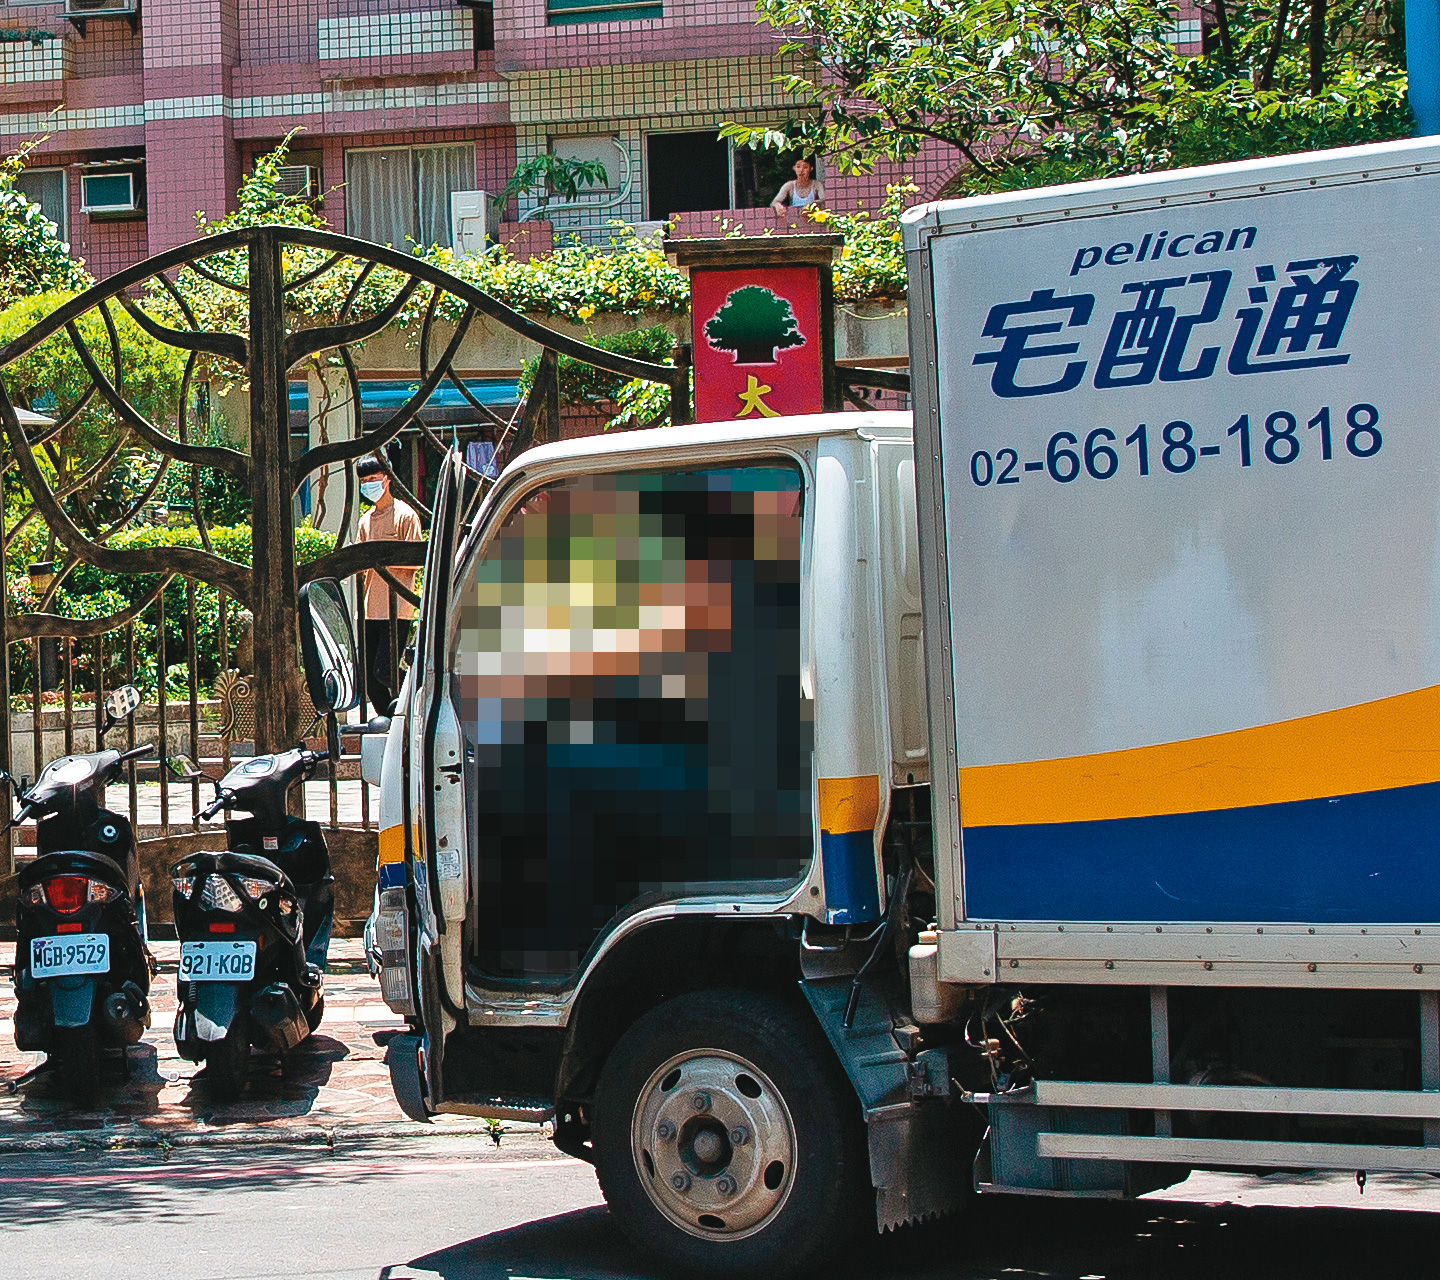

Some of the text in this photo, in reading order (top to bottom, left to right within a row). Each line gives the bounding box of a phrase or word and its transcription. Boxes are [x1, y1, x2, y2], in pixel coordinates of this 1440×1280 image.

[1069, 225, 1258, 276] pelican
[971, 254, 1360, 398] 宅配通
[734, 374, 781, 417] 大
[969, 403, 1384, 487] 02-6618-1818
[33, 943, 107, 969] MGB-9529
[181, 954, 253, 974] 921-KQB
